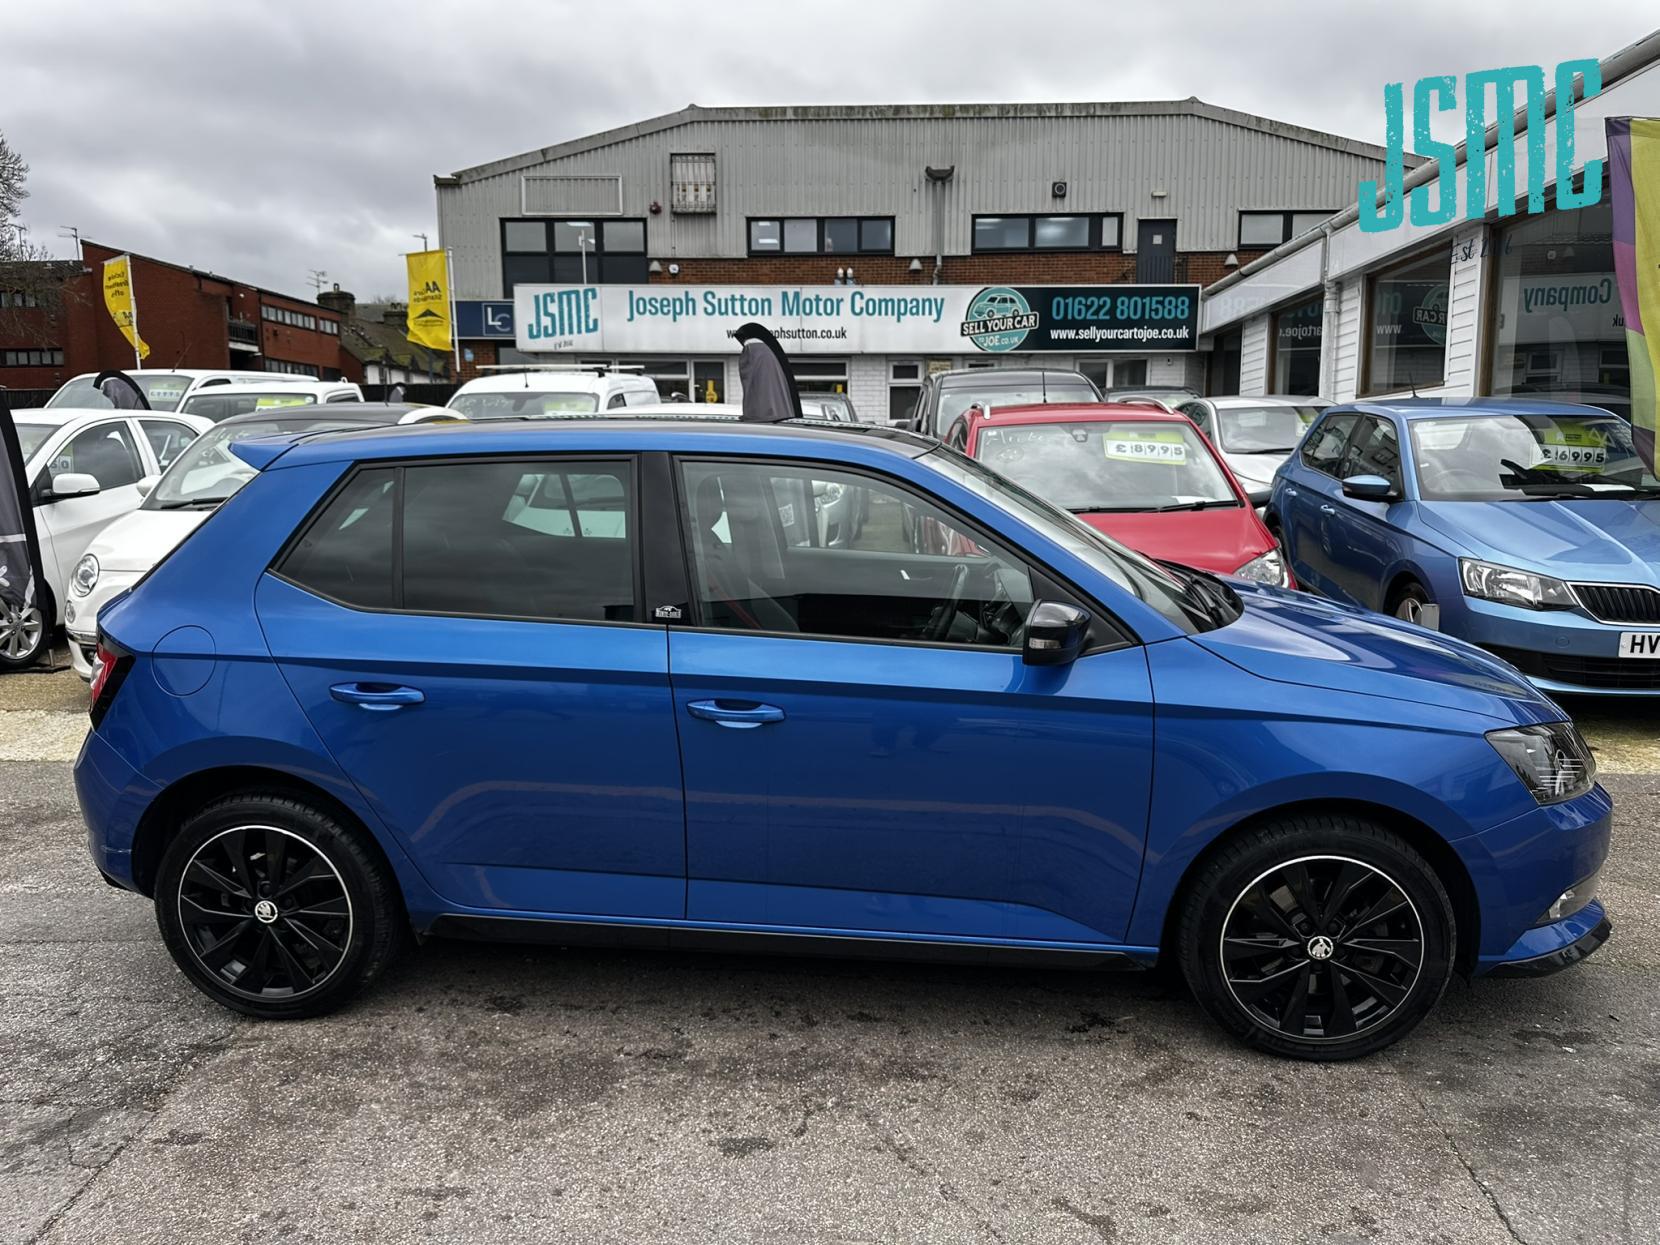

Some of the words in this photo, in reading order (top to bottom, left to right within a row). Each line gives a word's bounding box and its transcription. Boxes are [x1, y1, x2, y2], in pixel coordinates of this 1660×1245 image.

[528, 288, 599, 340] JSMC
[627, 290, 696, 322] Joseph
[703, 290, 772, 317] Sutton
[781, 291, 844, 317] Motor
[850, 291, 944, 323] Company
[1051, 296, 1111, 320] 01622
[1115, 296, 1189, 320] 801588
[726, 326, 847, 340] wphsutton.co.uk
[962, 322, 985, 336] SELL
[986, 319, 1013, 332] YOUR
[1014, 315, 1036, 328] CAR
[1050, 325, 1189, 342] www.sellyourcartojoe.co.uk
[1115, 443, 1183, 456] £8995
[1541, 448, 1605, 463] £6995
